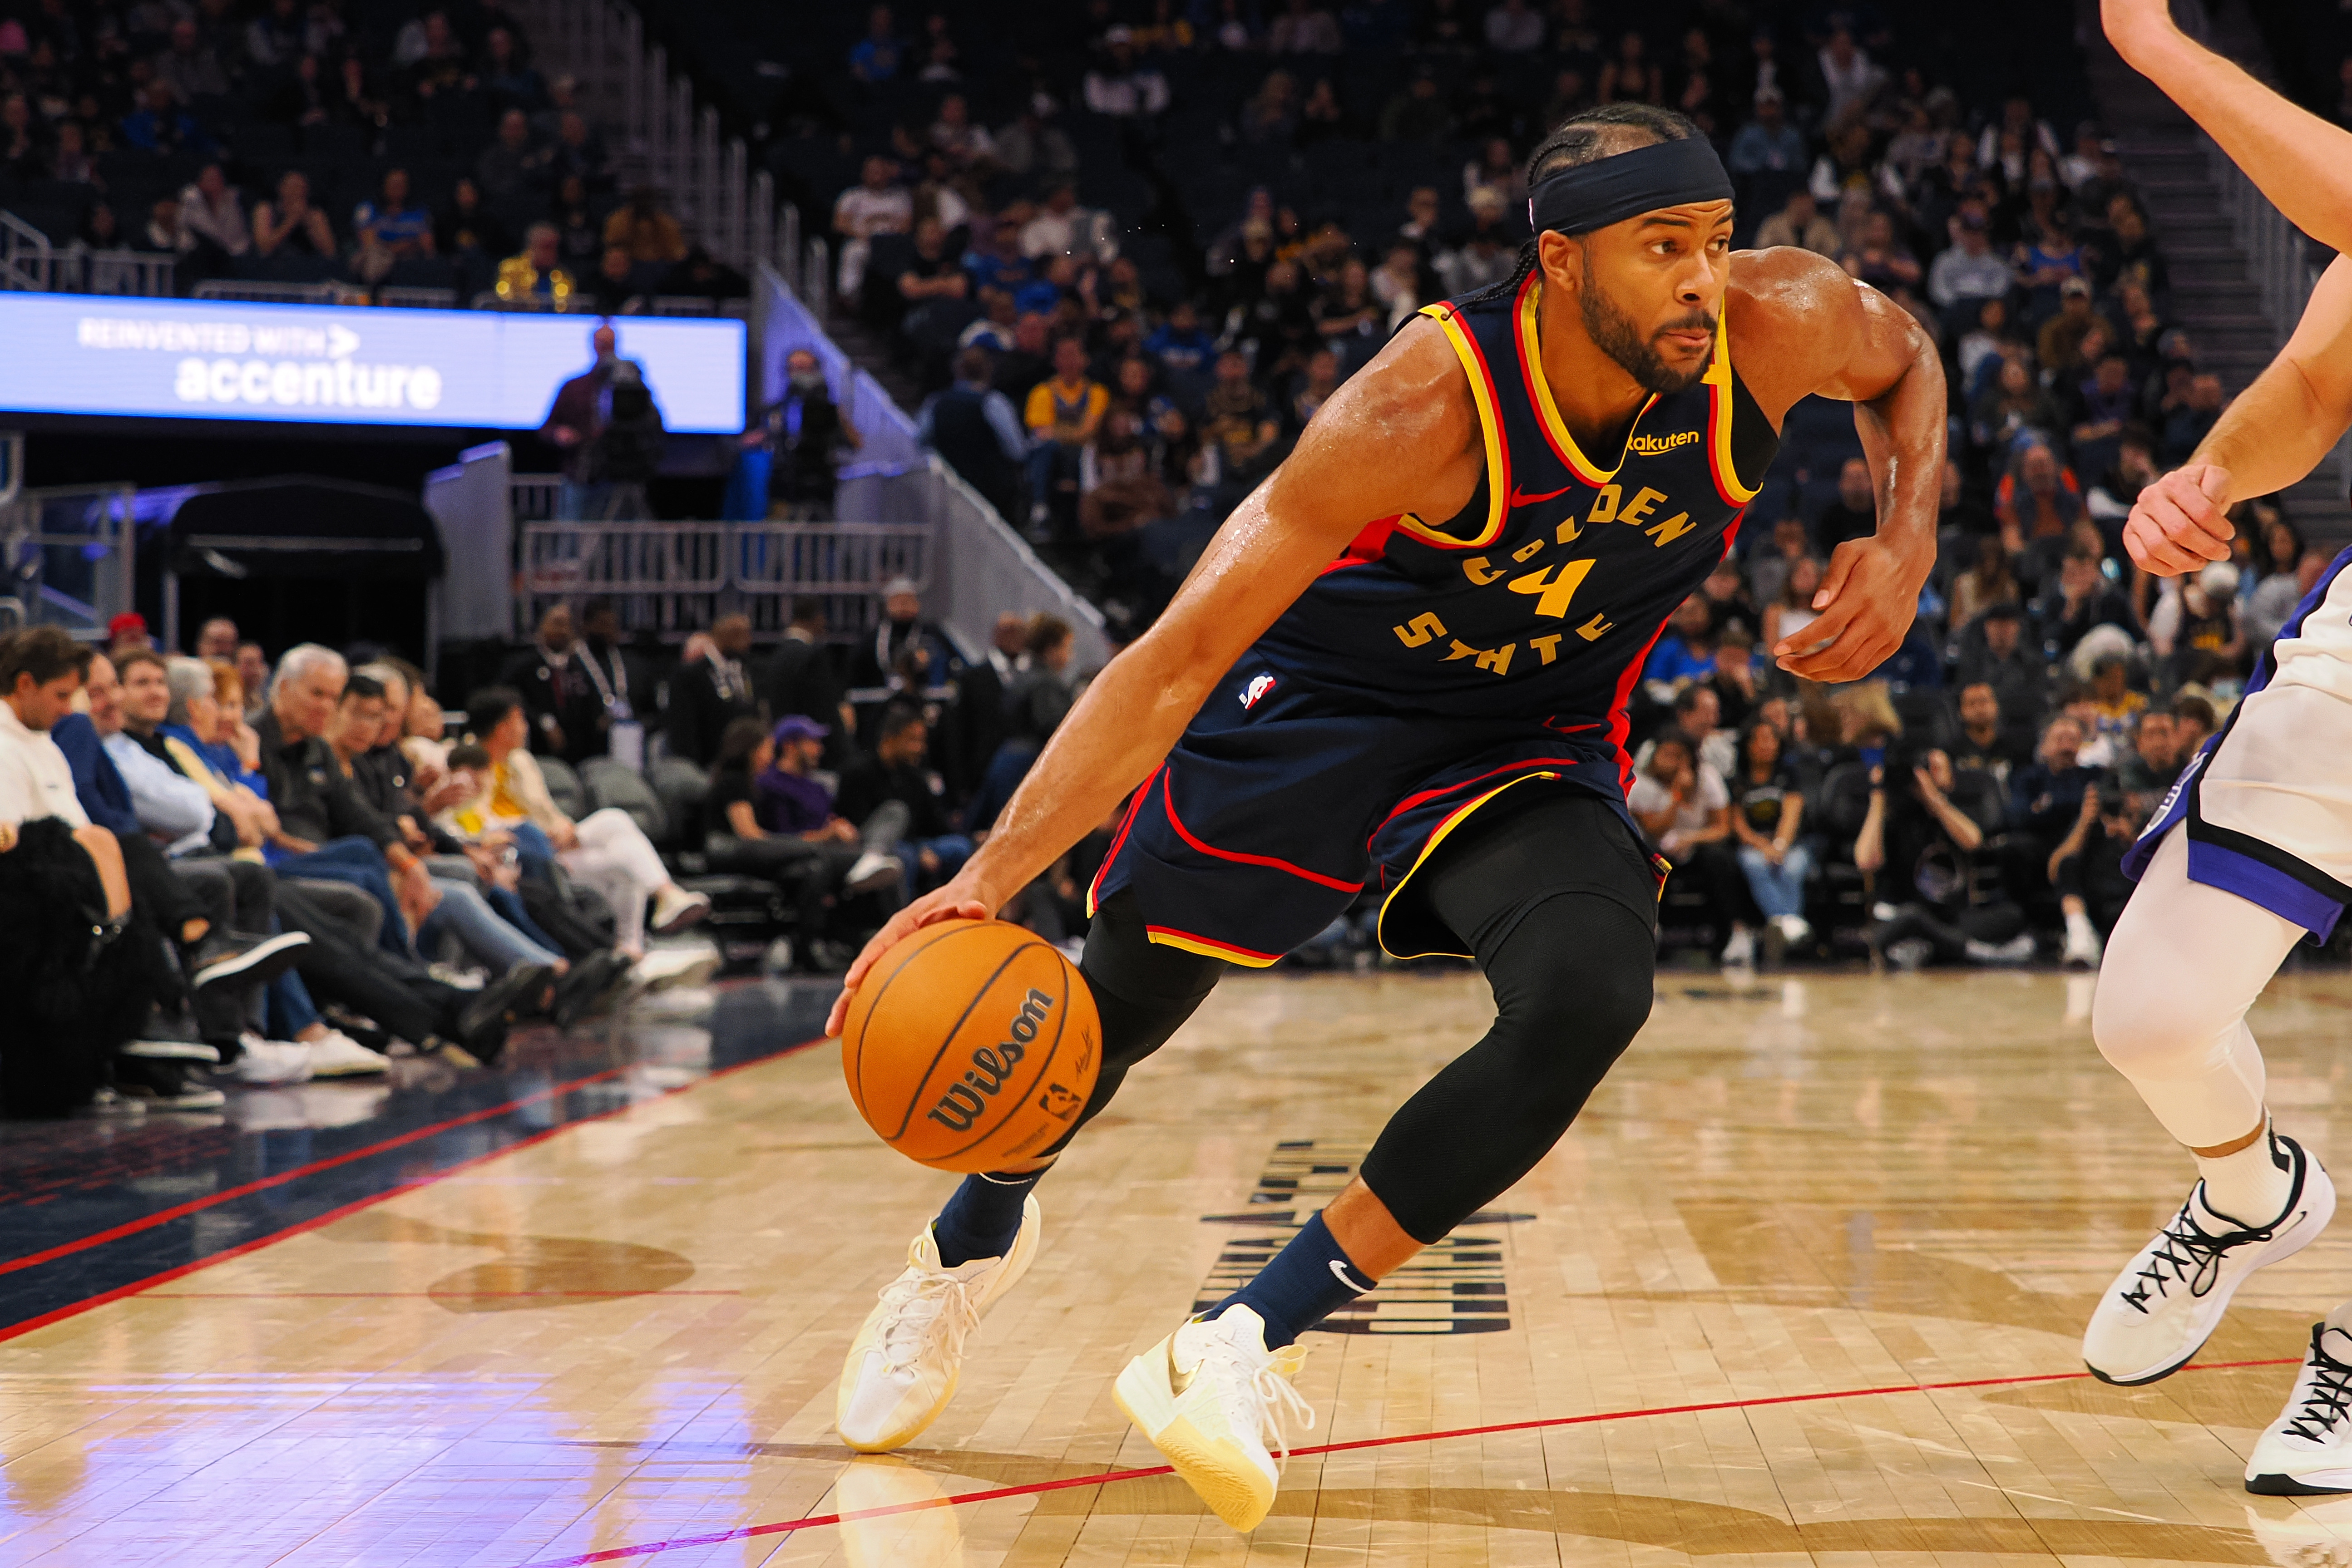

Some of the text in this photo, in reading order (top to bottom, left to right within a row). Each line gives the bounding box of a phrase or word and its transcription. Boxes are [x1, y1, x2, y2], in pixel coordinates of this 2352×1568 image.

[78, 317, 326, 355] REINVENTED WITH
[174, 356, 442, 409] accenture
[1462, 484, 1697, 586] GOLDEN
[1507, 558, 1597, 619] 4
[926, 988, 1054, 1132] Wilson
